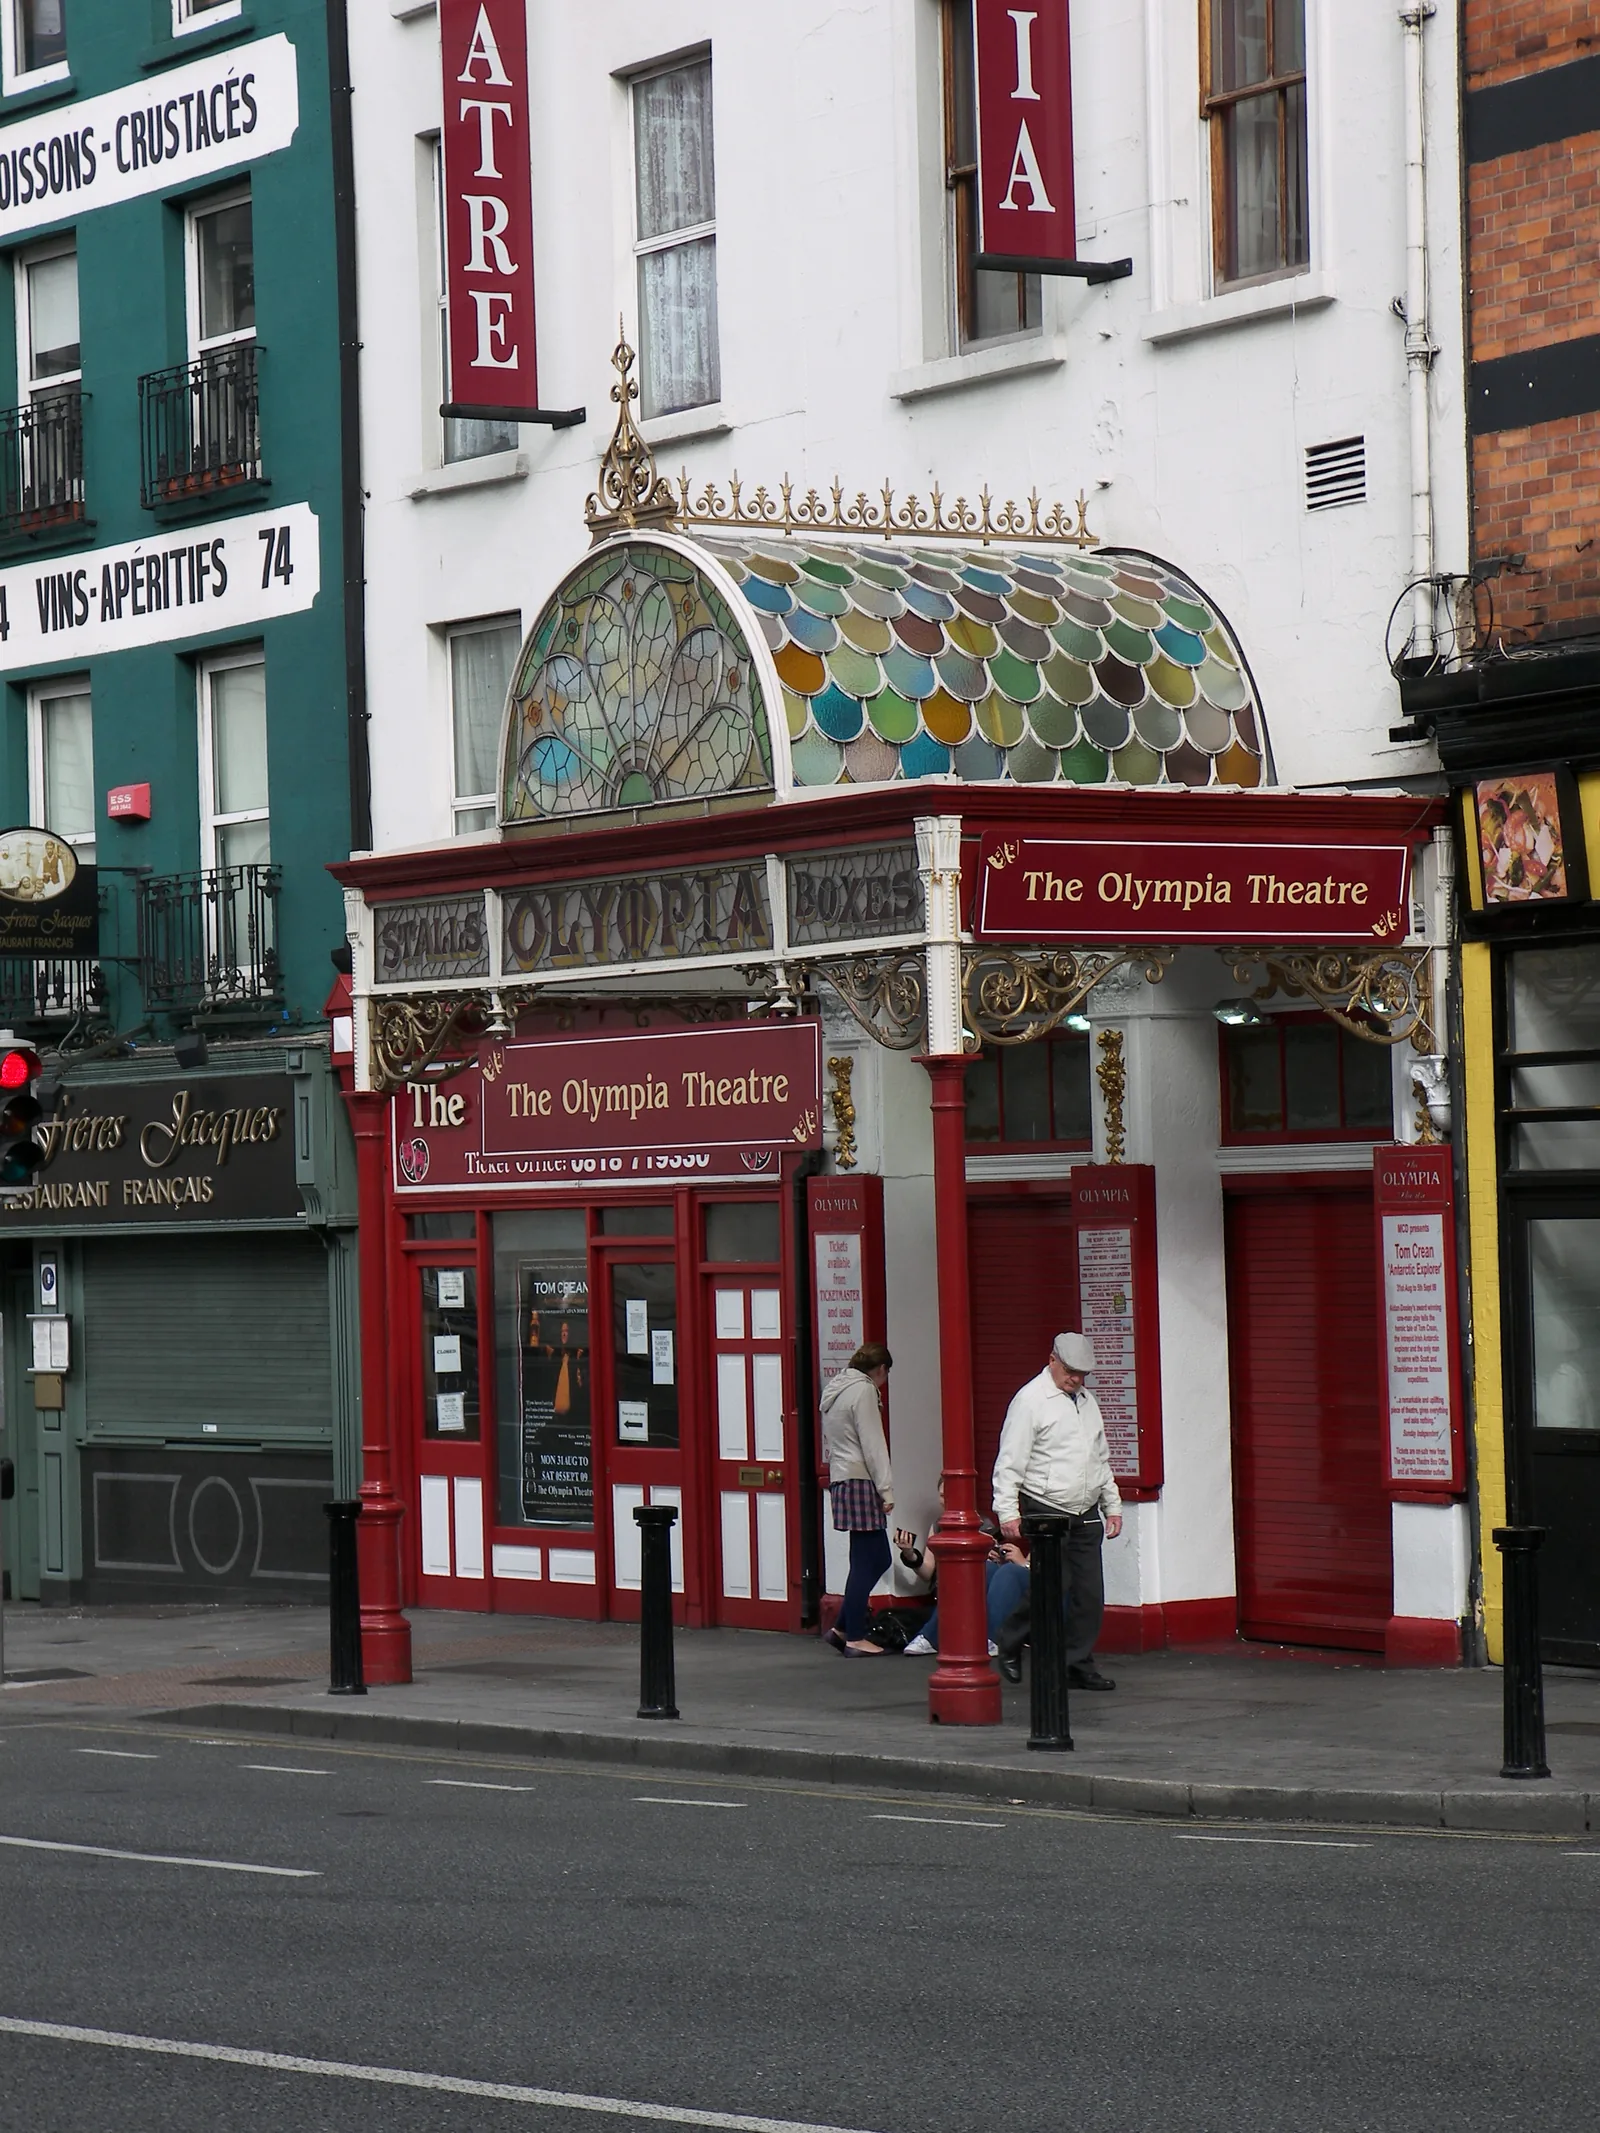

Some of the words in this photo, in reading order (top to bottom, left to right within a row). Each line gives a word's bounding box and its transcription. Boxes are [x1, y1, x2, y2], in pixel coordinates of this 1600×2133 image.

[258, 525, 294, 590] 74
[110, 793, 132, 805] ESS
[1022, 870, 1084, 902] The
[1097, 871, 1232, 911] Olympia
[1246, 874, 1369, 905] Theatre
[382, 910, 484, 974] STALLS
[506, 869, 771, 973] OLYMPIA
[796, 869, 926, 929] BOXES
[505, 1082, 553, 1118] The
[562, 1072, 670, 1123] Olympia
[681, 1067, 790, 1108] Theatre
[406, 1081, 466, 1128] The
[140, 1090, 285, 1168] Jacques
[1383, 1171, 1441, 1186] OLYMPIA
[123, 1175, 214, 1210] FRANÇAIS
[1079, 1189, 1130, 1202] OLYMPIA
[814, 1198, 859, 1211] OLYMPIA
[1409, 1224, 1430, 1235] presents
[829, 1240, 848, 1253] Tickets
[1395, 1243, 1411, 1259] Tom
[1412, 1243, 1434, 1259] Crean
[827, 1257, 851, 1269] available
[833, 1273, 846, 1285] from
[533, 1281, 556, 1294] TOM
[819, 1289, 861, 1302] TICKETMASTER
[827, 1306, 838, 1318] and
[839, 1306, 854, 1318] usual
[831, 1322, 851, 1335] outlets
[827, 1338, 856, 1351] nationwide
[540, 1454, 556, 1465] MON
[578, 1456, 589, 1466] TO
[541, 1470, 555, 1481] SAT
[537, 1485, 547, 1495] The
[548, 1485, 573, 1498] Olympia
